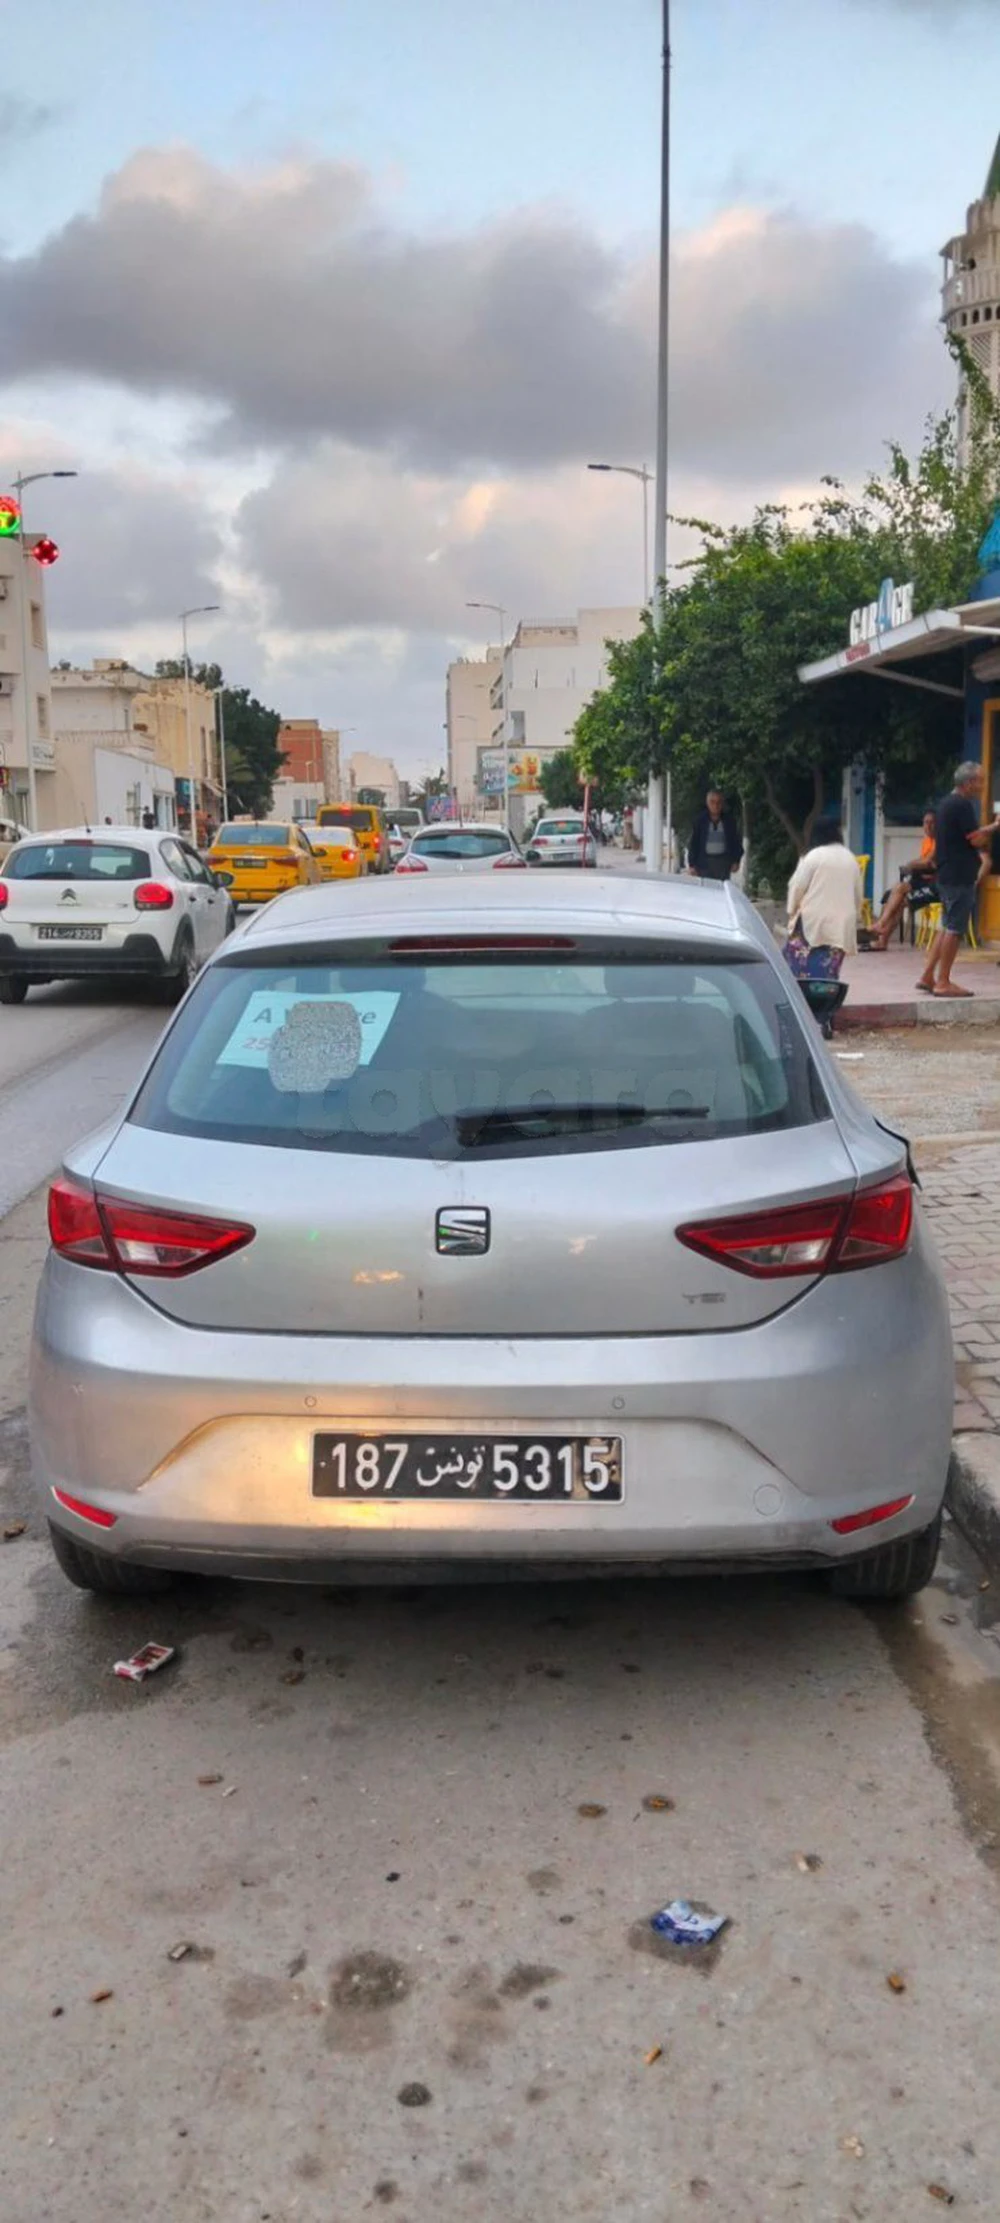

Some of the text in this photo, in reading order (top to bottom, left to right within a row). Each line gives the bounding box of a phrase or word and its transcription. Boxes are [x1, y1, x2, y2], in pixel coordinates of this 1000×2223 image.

[252, 1007, 272, 1024] A
[332, 1442, 610, 1492] 187 تونس 5315
